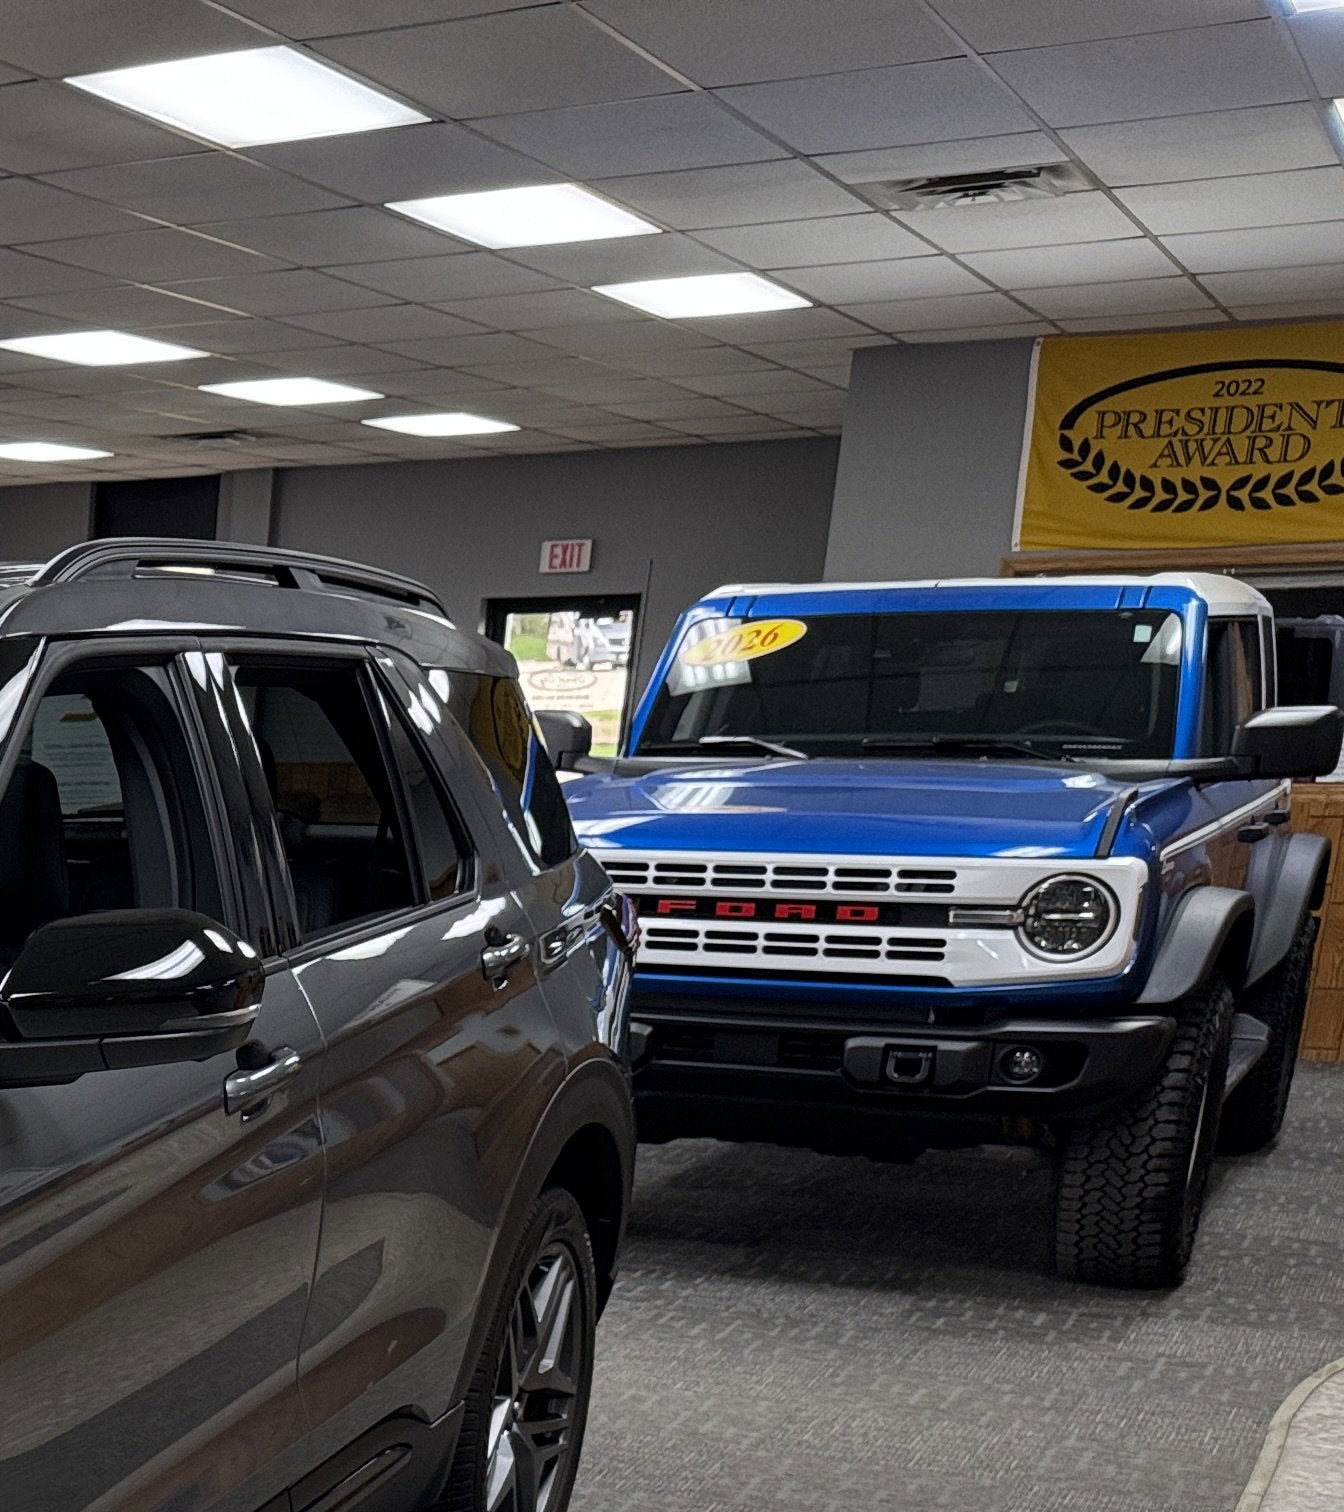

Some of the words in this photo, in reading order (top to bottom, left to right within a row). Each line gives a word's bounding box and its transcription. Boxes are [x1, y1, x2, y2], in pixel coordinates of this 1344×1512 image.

[1212, 378, 1266, 398] 2022
[1148, 432, 1312, 469] AWARD
[548, 542, 585, 570] EXIT
[700, 622, 786, 663] 2026
[657, 900, 881, 922] FORD
